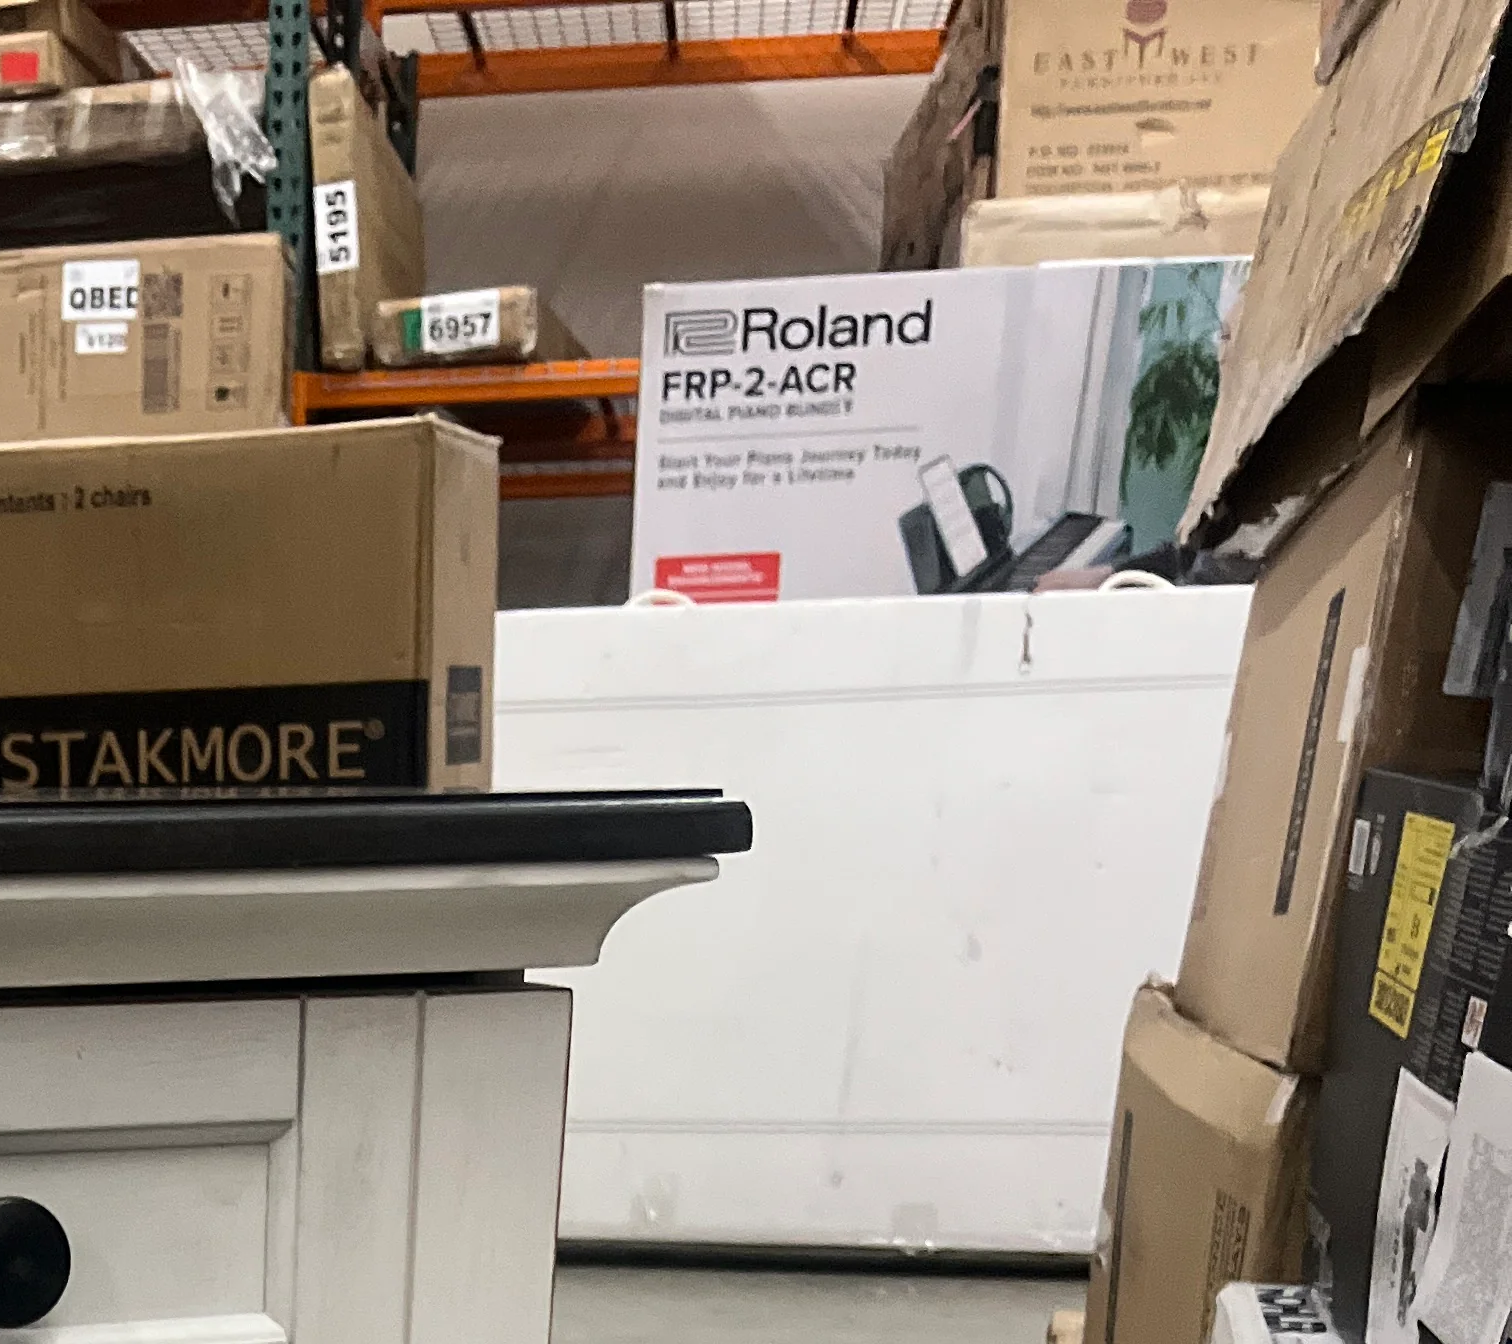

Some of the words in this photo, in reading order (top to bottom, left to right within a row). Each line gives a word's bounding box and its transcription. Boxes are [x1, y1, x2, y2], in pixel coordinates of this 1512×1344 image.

[325, 190, 351, 262] 5195
[429, 312, 492, 341] 6957
[741, 298, 934, 352] Roland
[661, 362, 856, 401] FRP-2-ACR
[90, 485, 152, 509] chairs
[0, 720, 367, 790] STAKMORE
